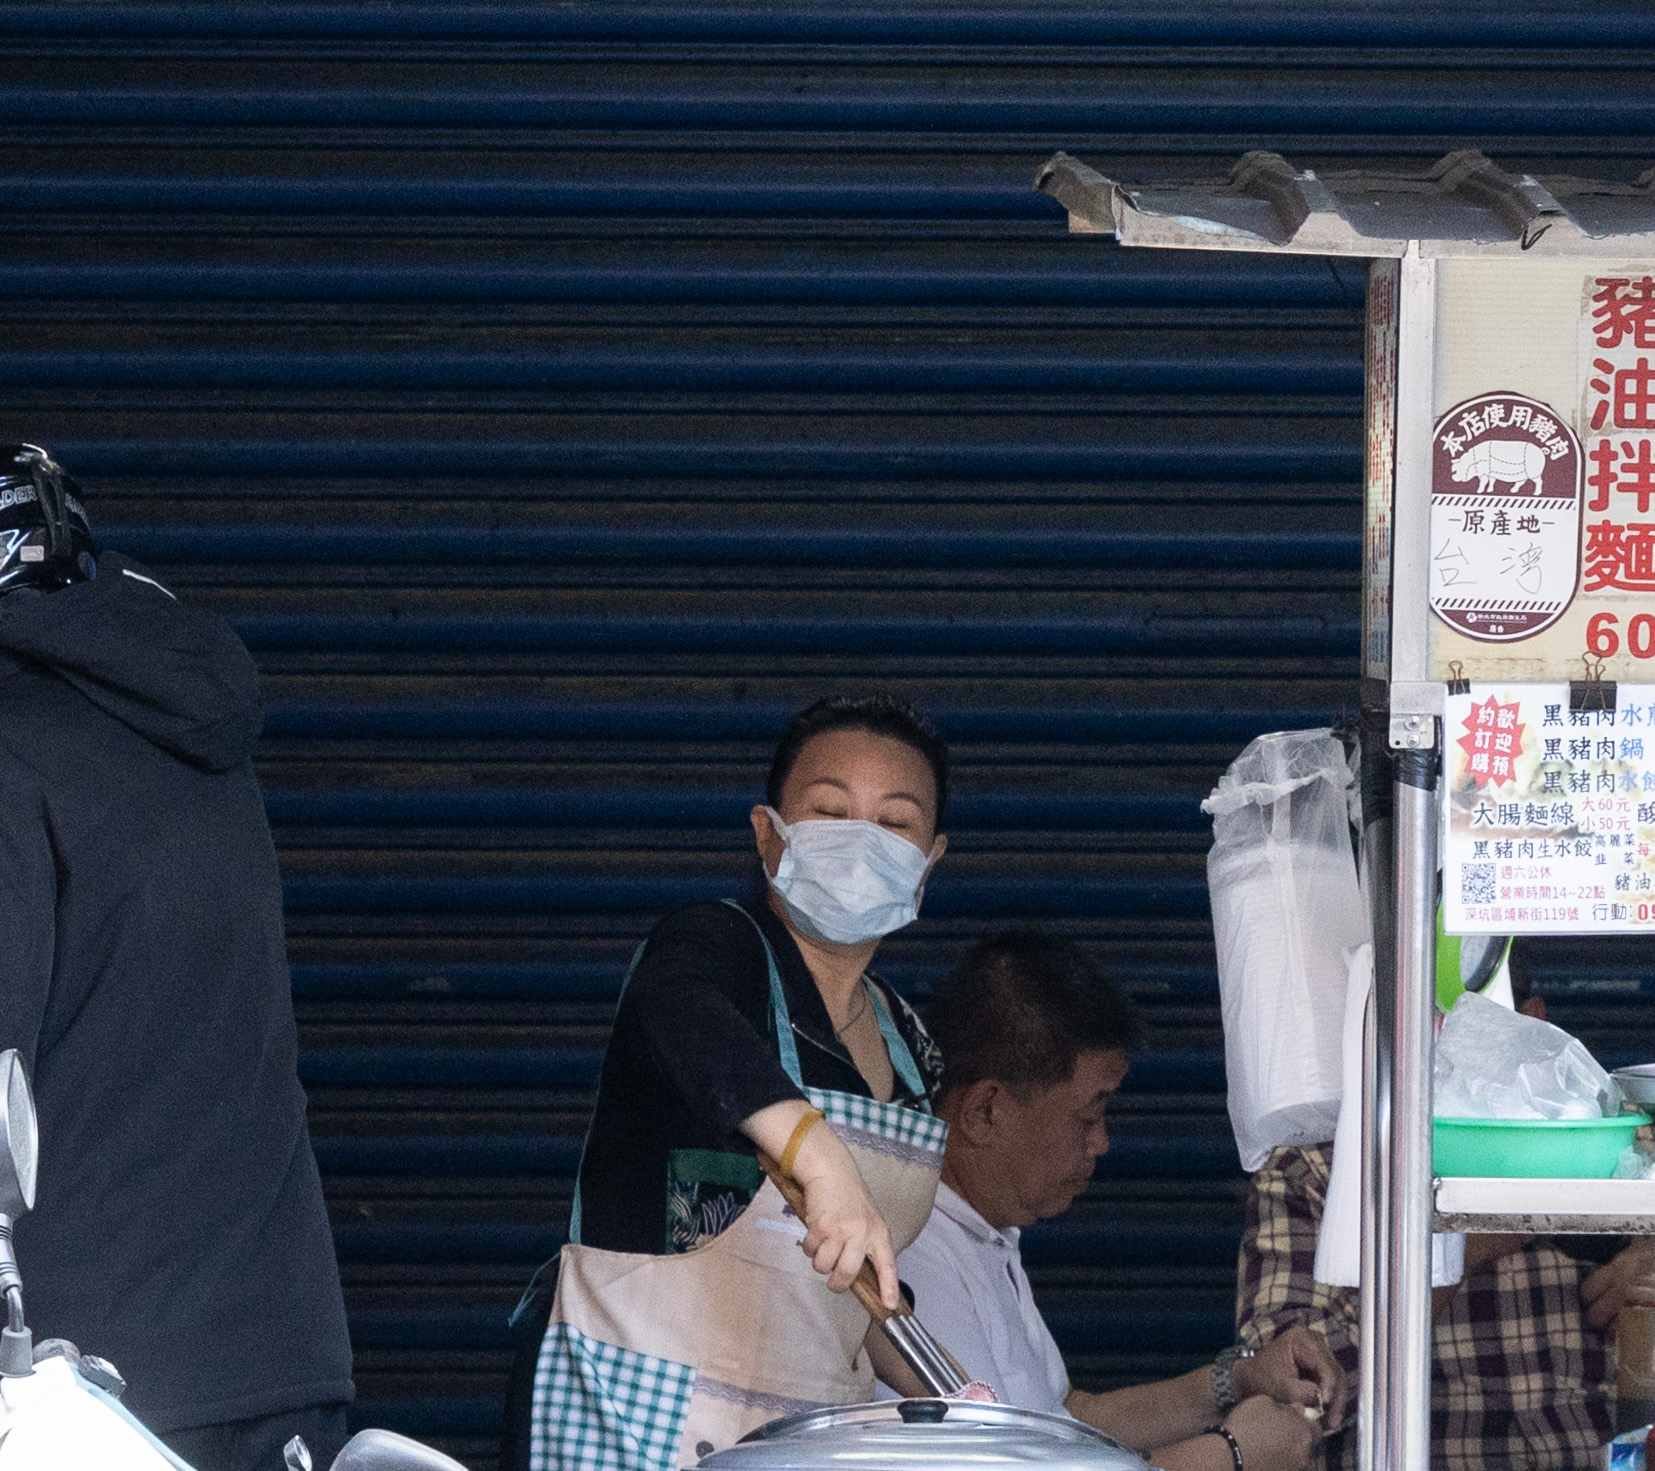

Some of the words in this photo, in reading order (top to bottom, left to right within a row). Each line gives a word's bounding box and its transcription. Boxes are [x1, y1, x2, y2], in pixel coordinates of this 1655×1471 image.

[1441, 403, 1570, 461] 本店使用豬肉
[1462, 509, 1542, 536] 原產地
[1473, 801, 1575, 826] 大腸麵線
[1581, 796, 1631, 812] 大60元
[1580, 815, 1631, 831] 小50元
[1472, 838, 1592, 860] 黑豬肉生水餃
